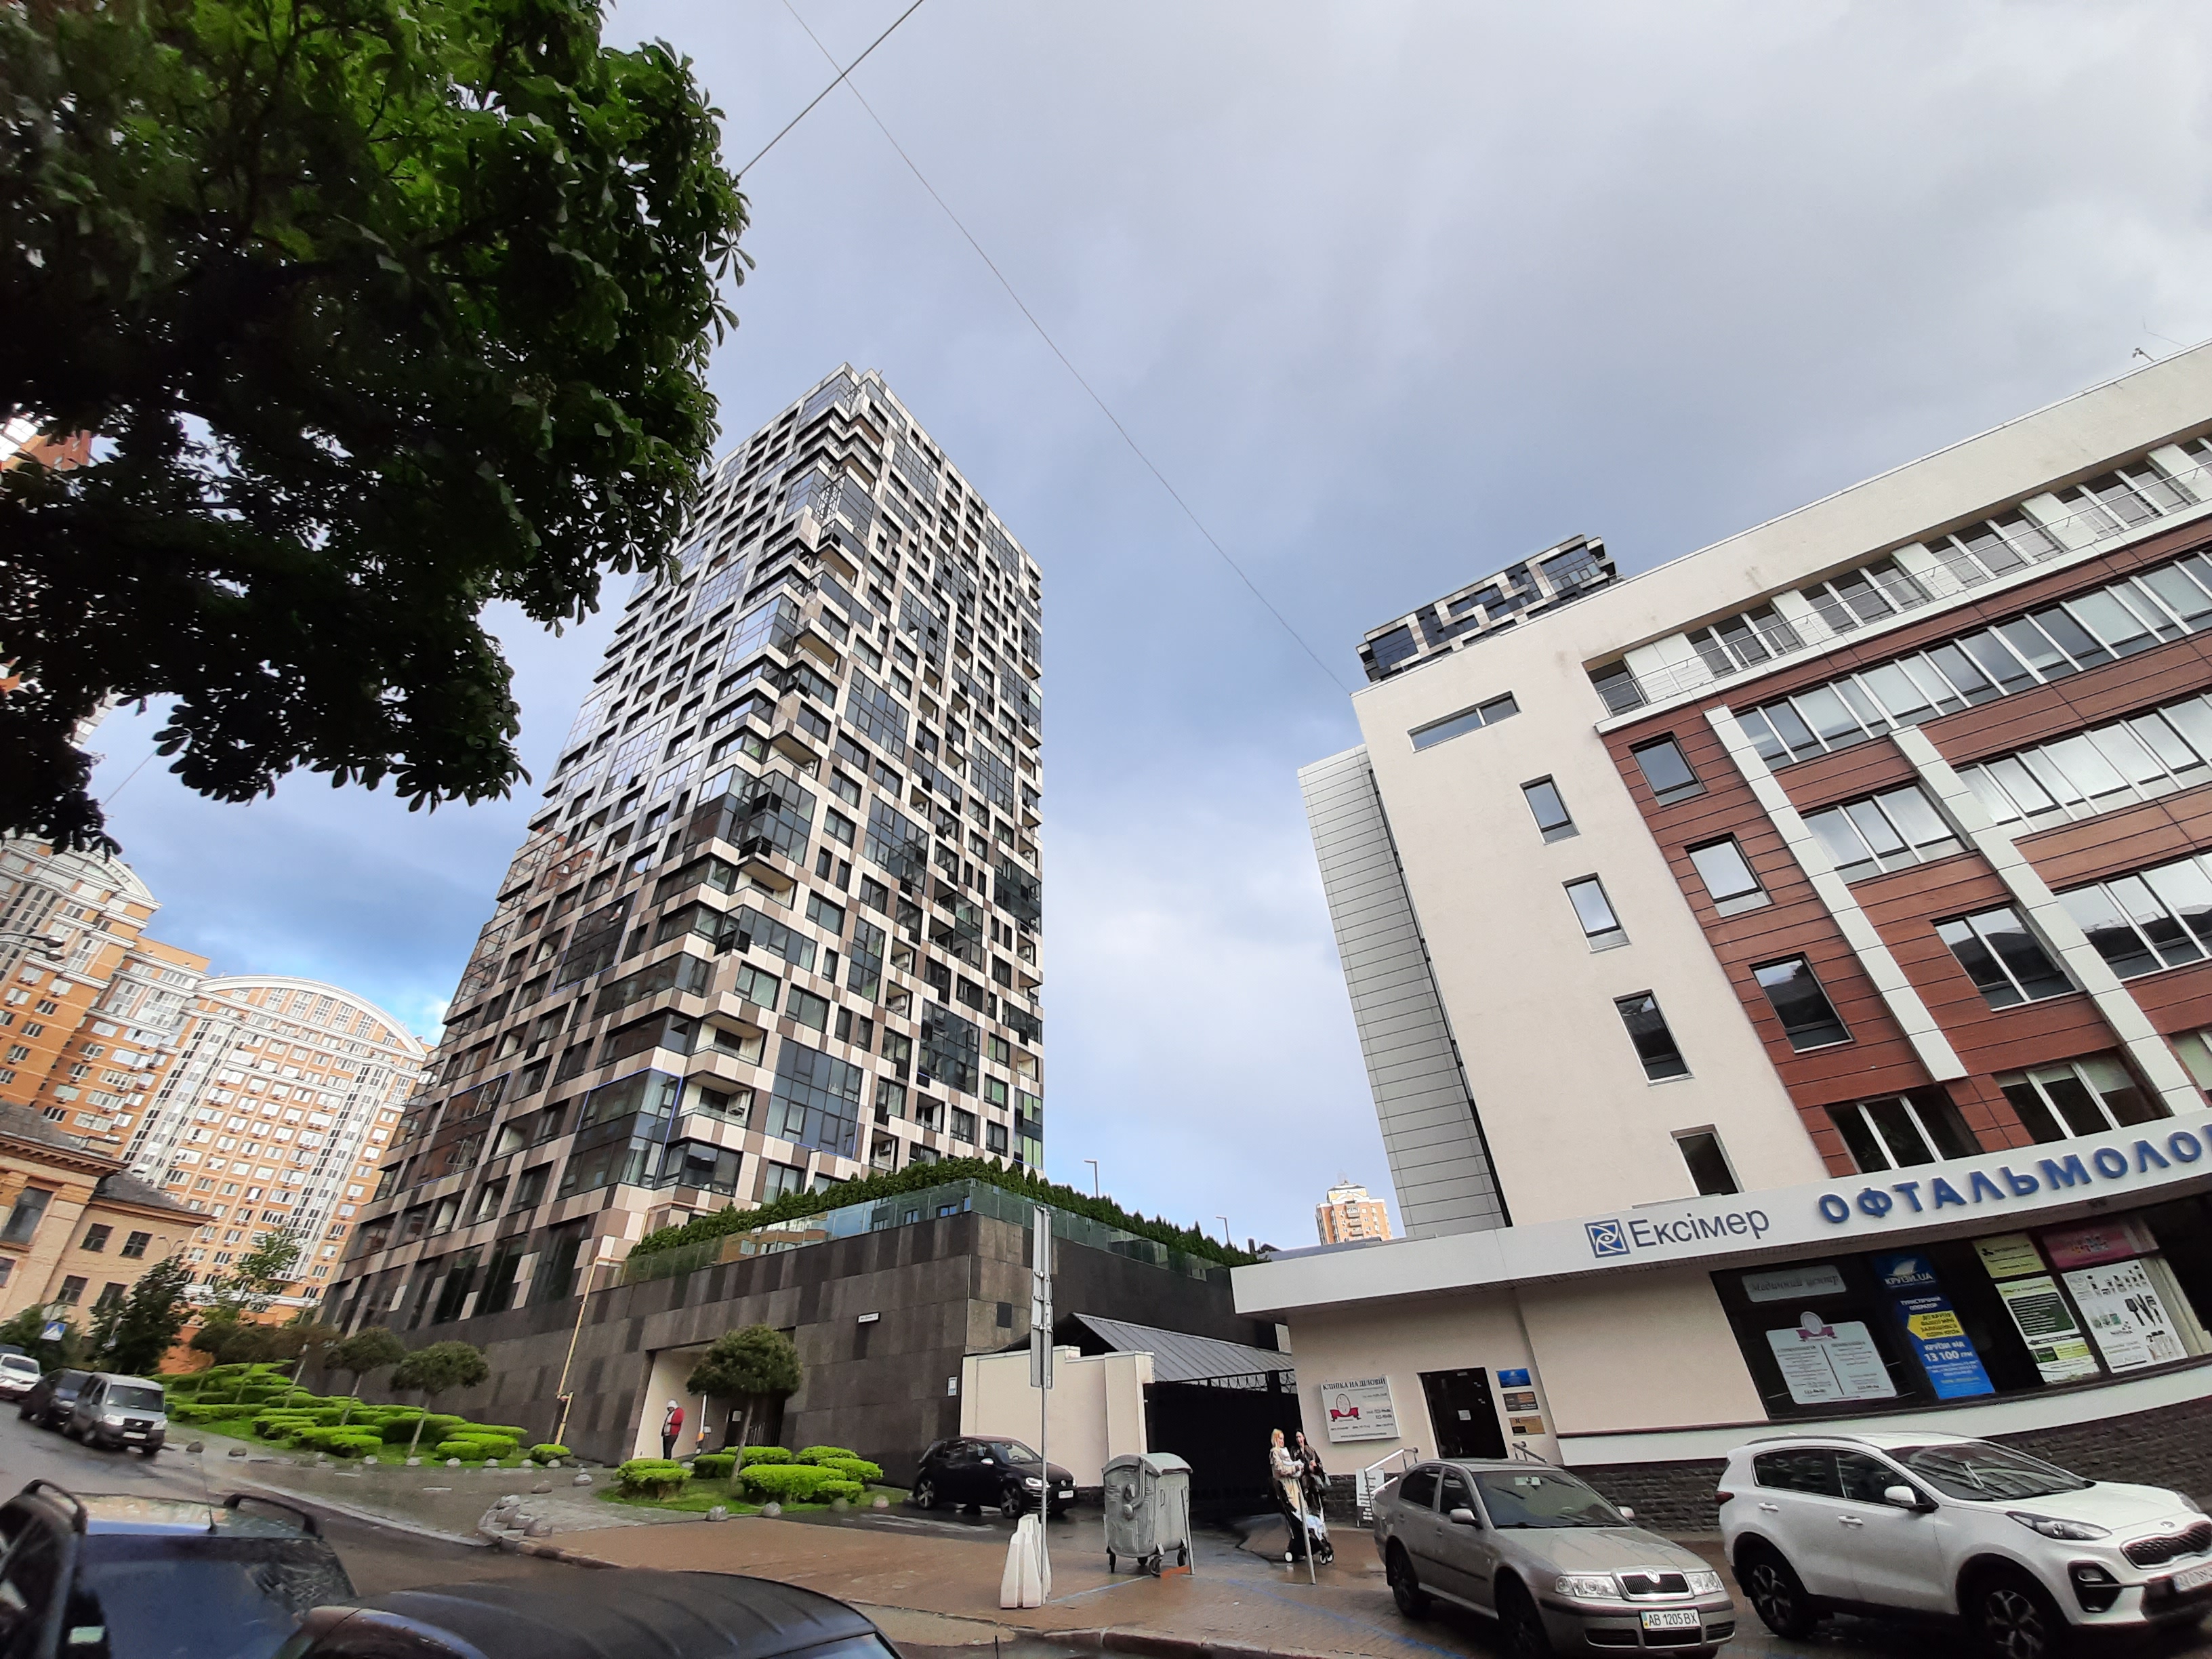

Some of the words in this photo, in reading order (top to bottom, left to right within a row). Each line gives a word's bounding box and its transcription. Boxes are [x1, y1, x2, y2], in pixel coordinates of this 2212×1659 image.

[1818, 1124, 2212, 1224] ОФТАЛЬМОЛО
[1628, 1210, 1770, 1248] Ексімер
[1924, 1353, 1939, 1362] 13
[1939, 1350, 1960, 1361] 100
[1662, 1613, 1683, 1624] 1205
